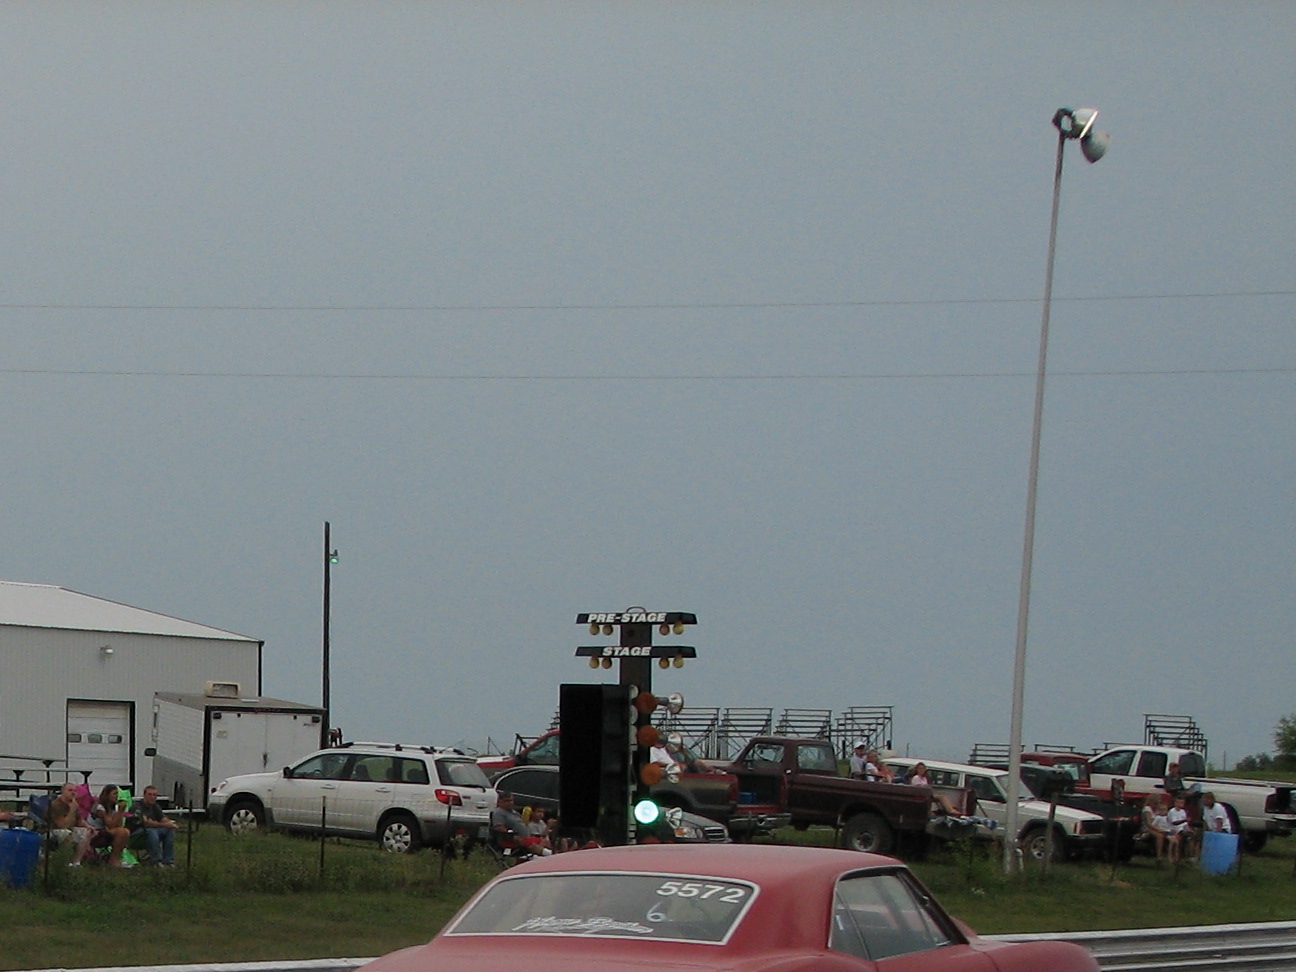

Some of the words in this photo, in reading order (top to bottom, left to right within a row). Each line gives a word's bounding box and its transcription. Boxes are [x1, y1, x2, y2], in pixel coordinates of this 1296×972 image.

[587, 612, 667, 623] PRE-STAGE
[602, 646, 652, 656] STAGE
[656, 881, 745, 904] 5572
